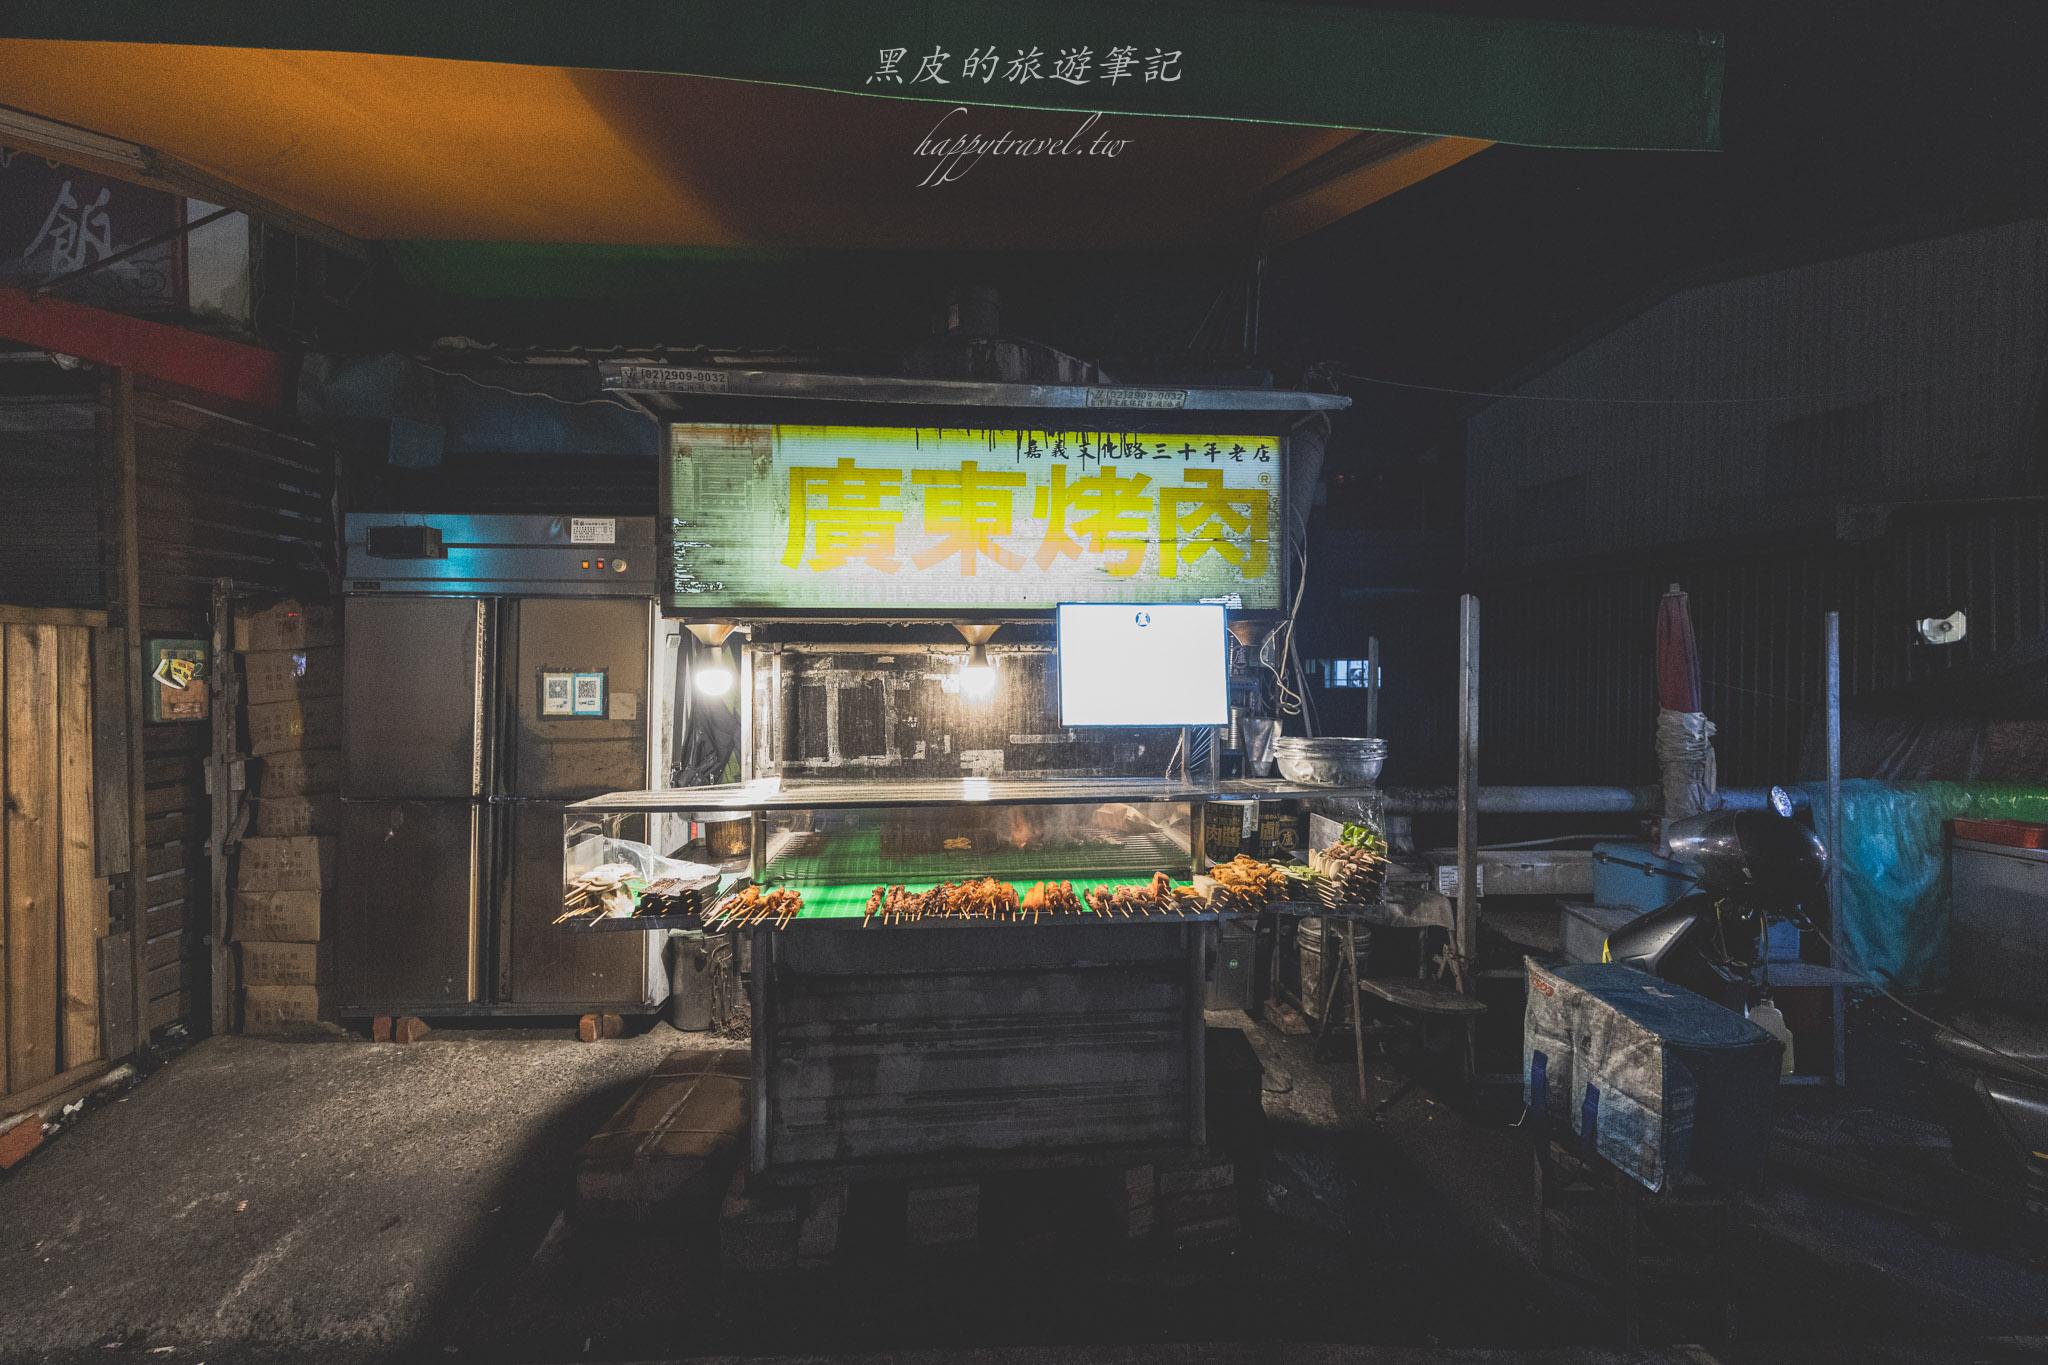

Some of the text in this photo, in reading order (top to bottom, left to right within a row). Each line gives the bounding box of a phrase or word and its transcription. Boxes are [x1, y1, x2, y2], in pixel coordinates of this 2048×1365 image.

[641, 369, 725, 382] (02)2909-0032
[1106, 390, 1183, 400] (02)2909-0032
[1024, 439, 1271, 463] 嘉義文化路三十年老店
[779, 457, 1269, 579] 廣東烤肉
